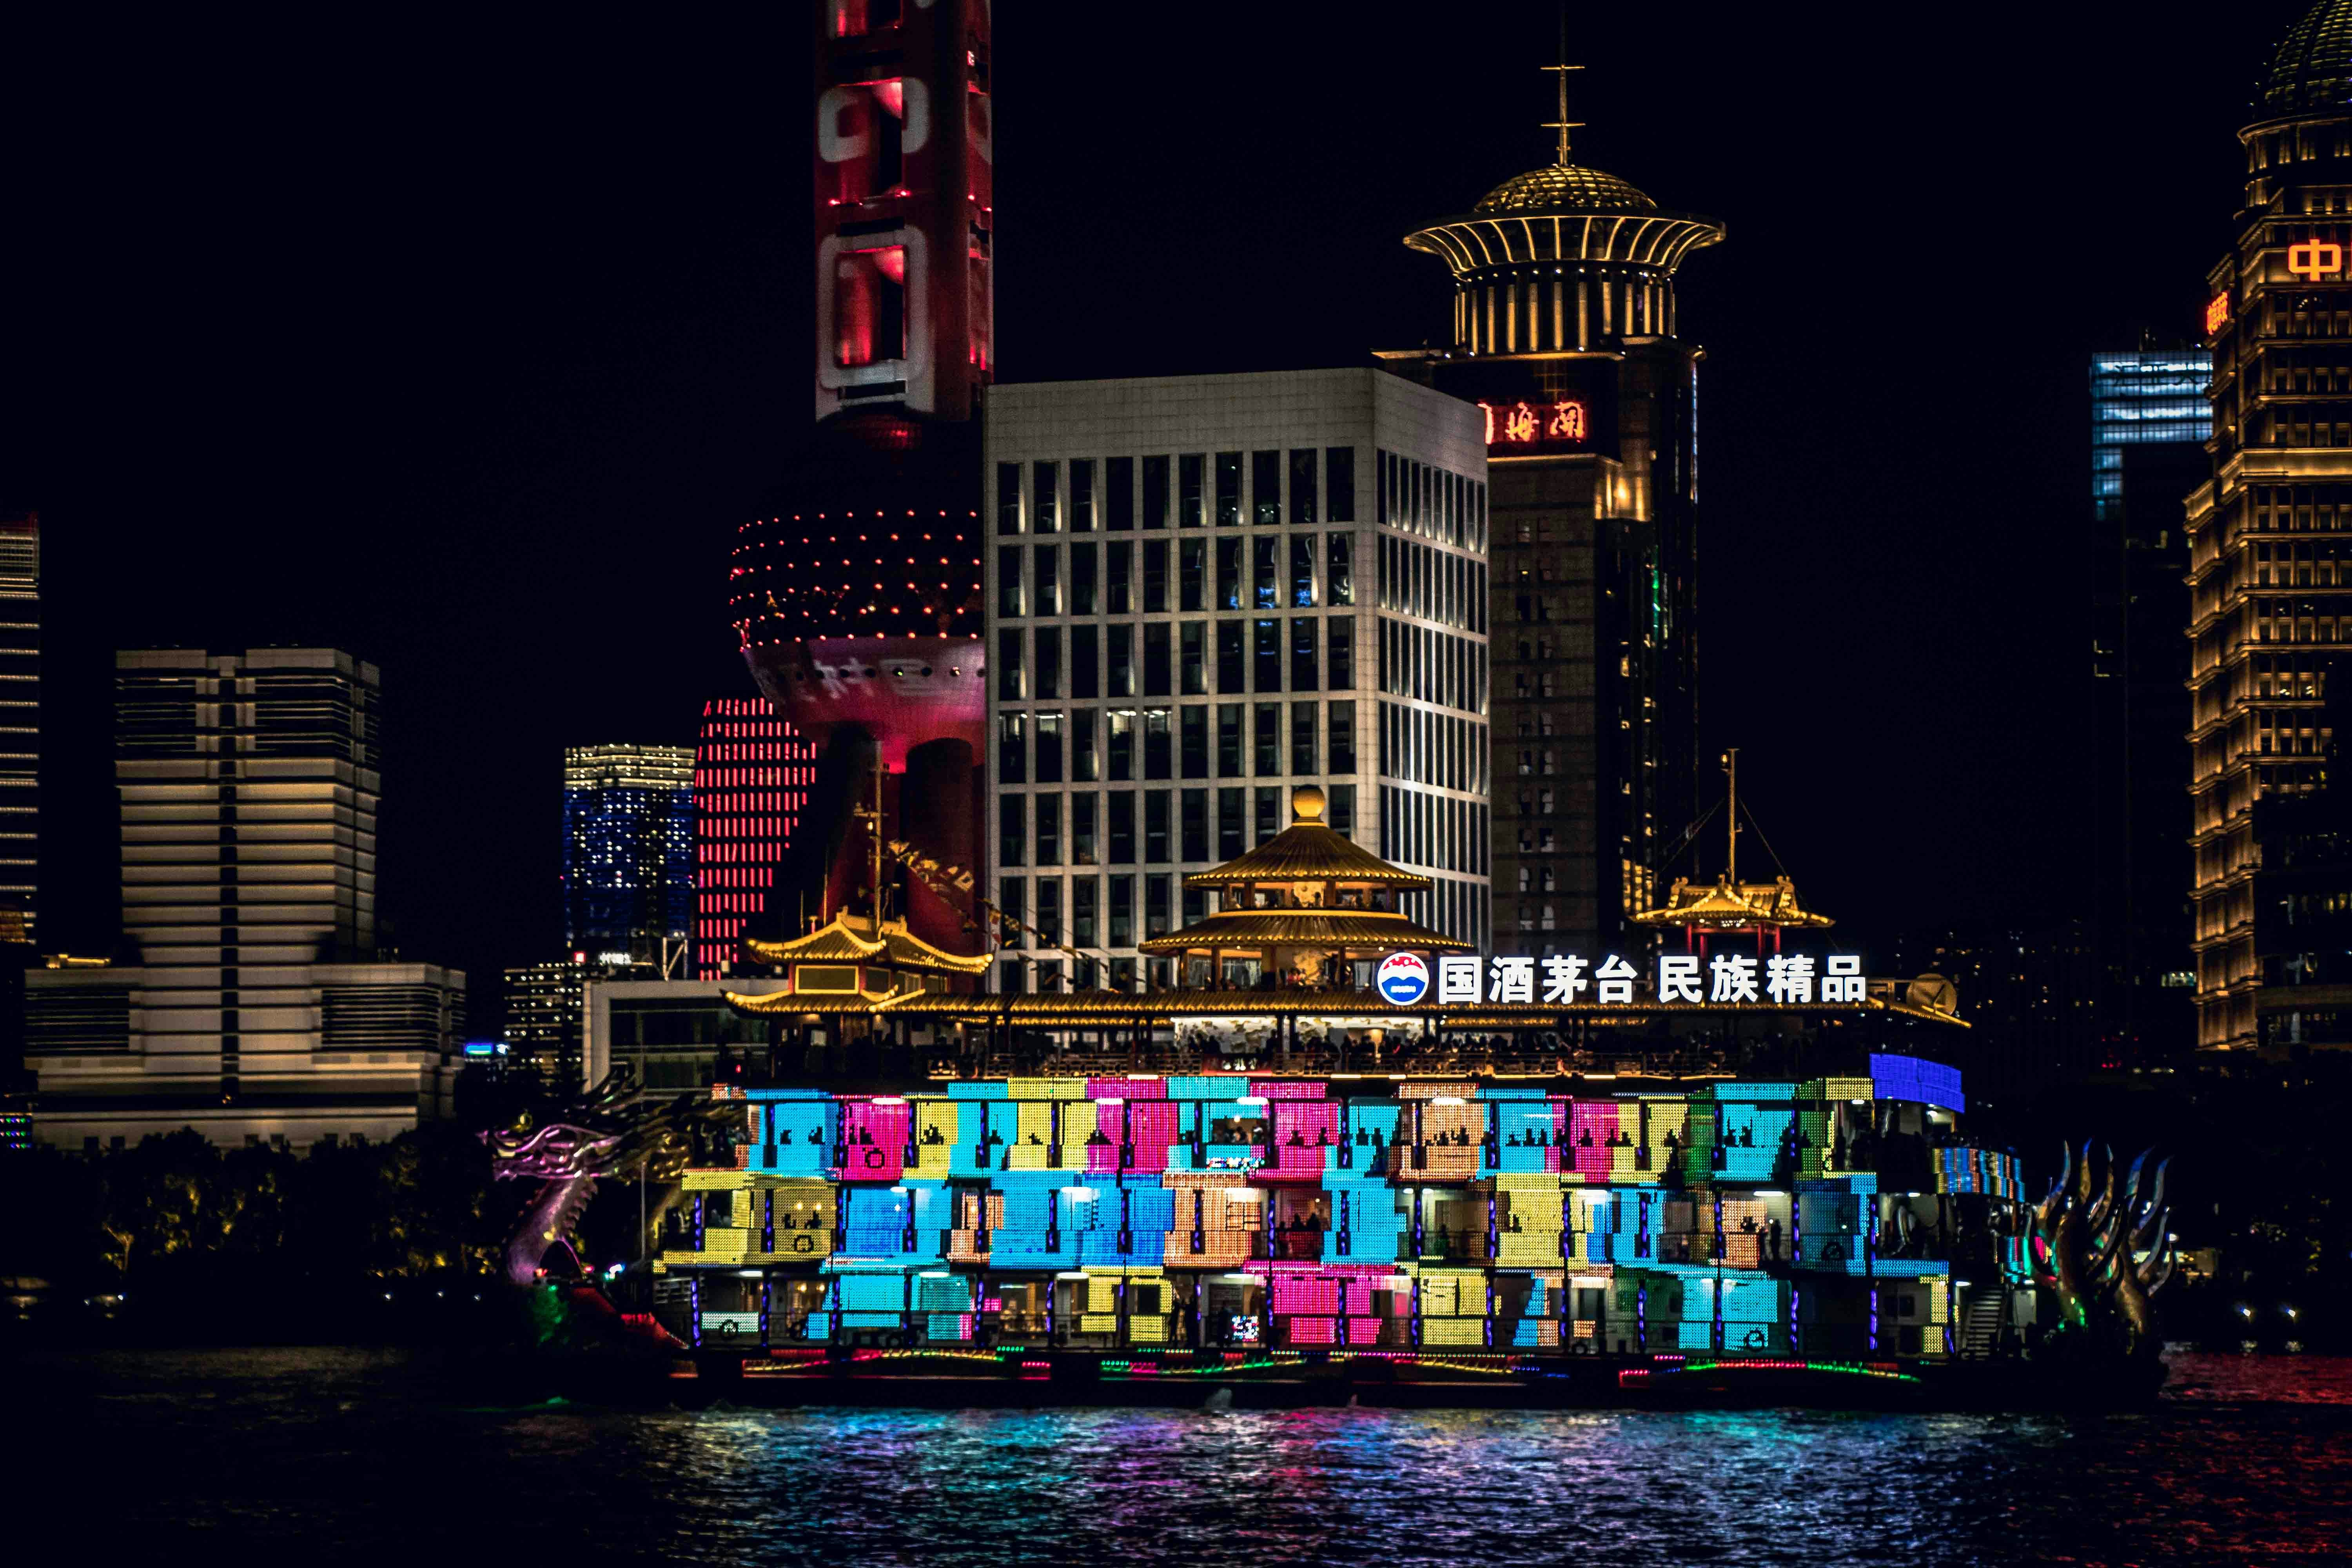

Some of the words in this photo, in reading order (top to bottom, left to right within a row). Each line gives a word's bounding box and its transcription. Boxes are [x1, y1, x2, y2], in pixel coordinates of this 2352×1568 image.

[1438, 954, 1638, 1004] 国酒茅台
[1659, 954, 1866, 1004] 民族精品
